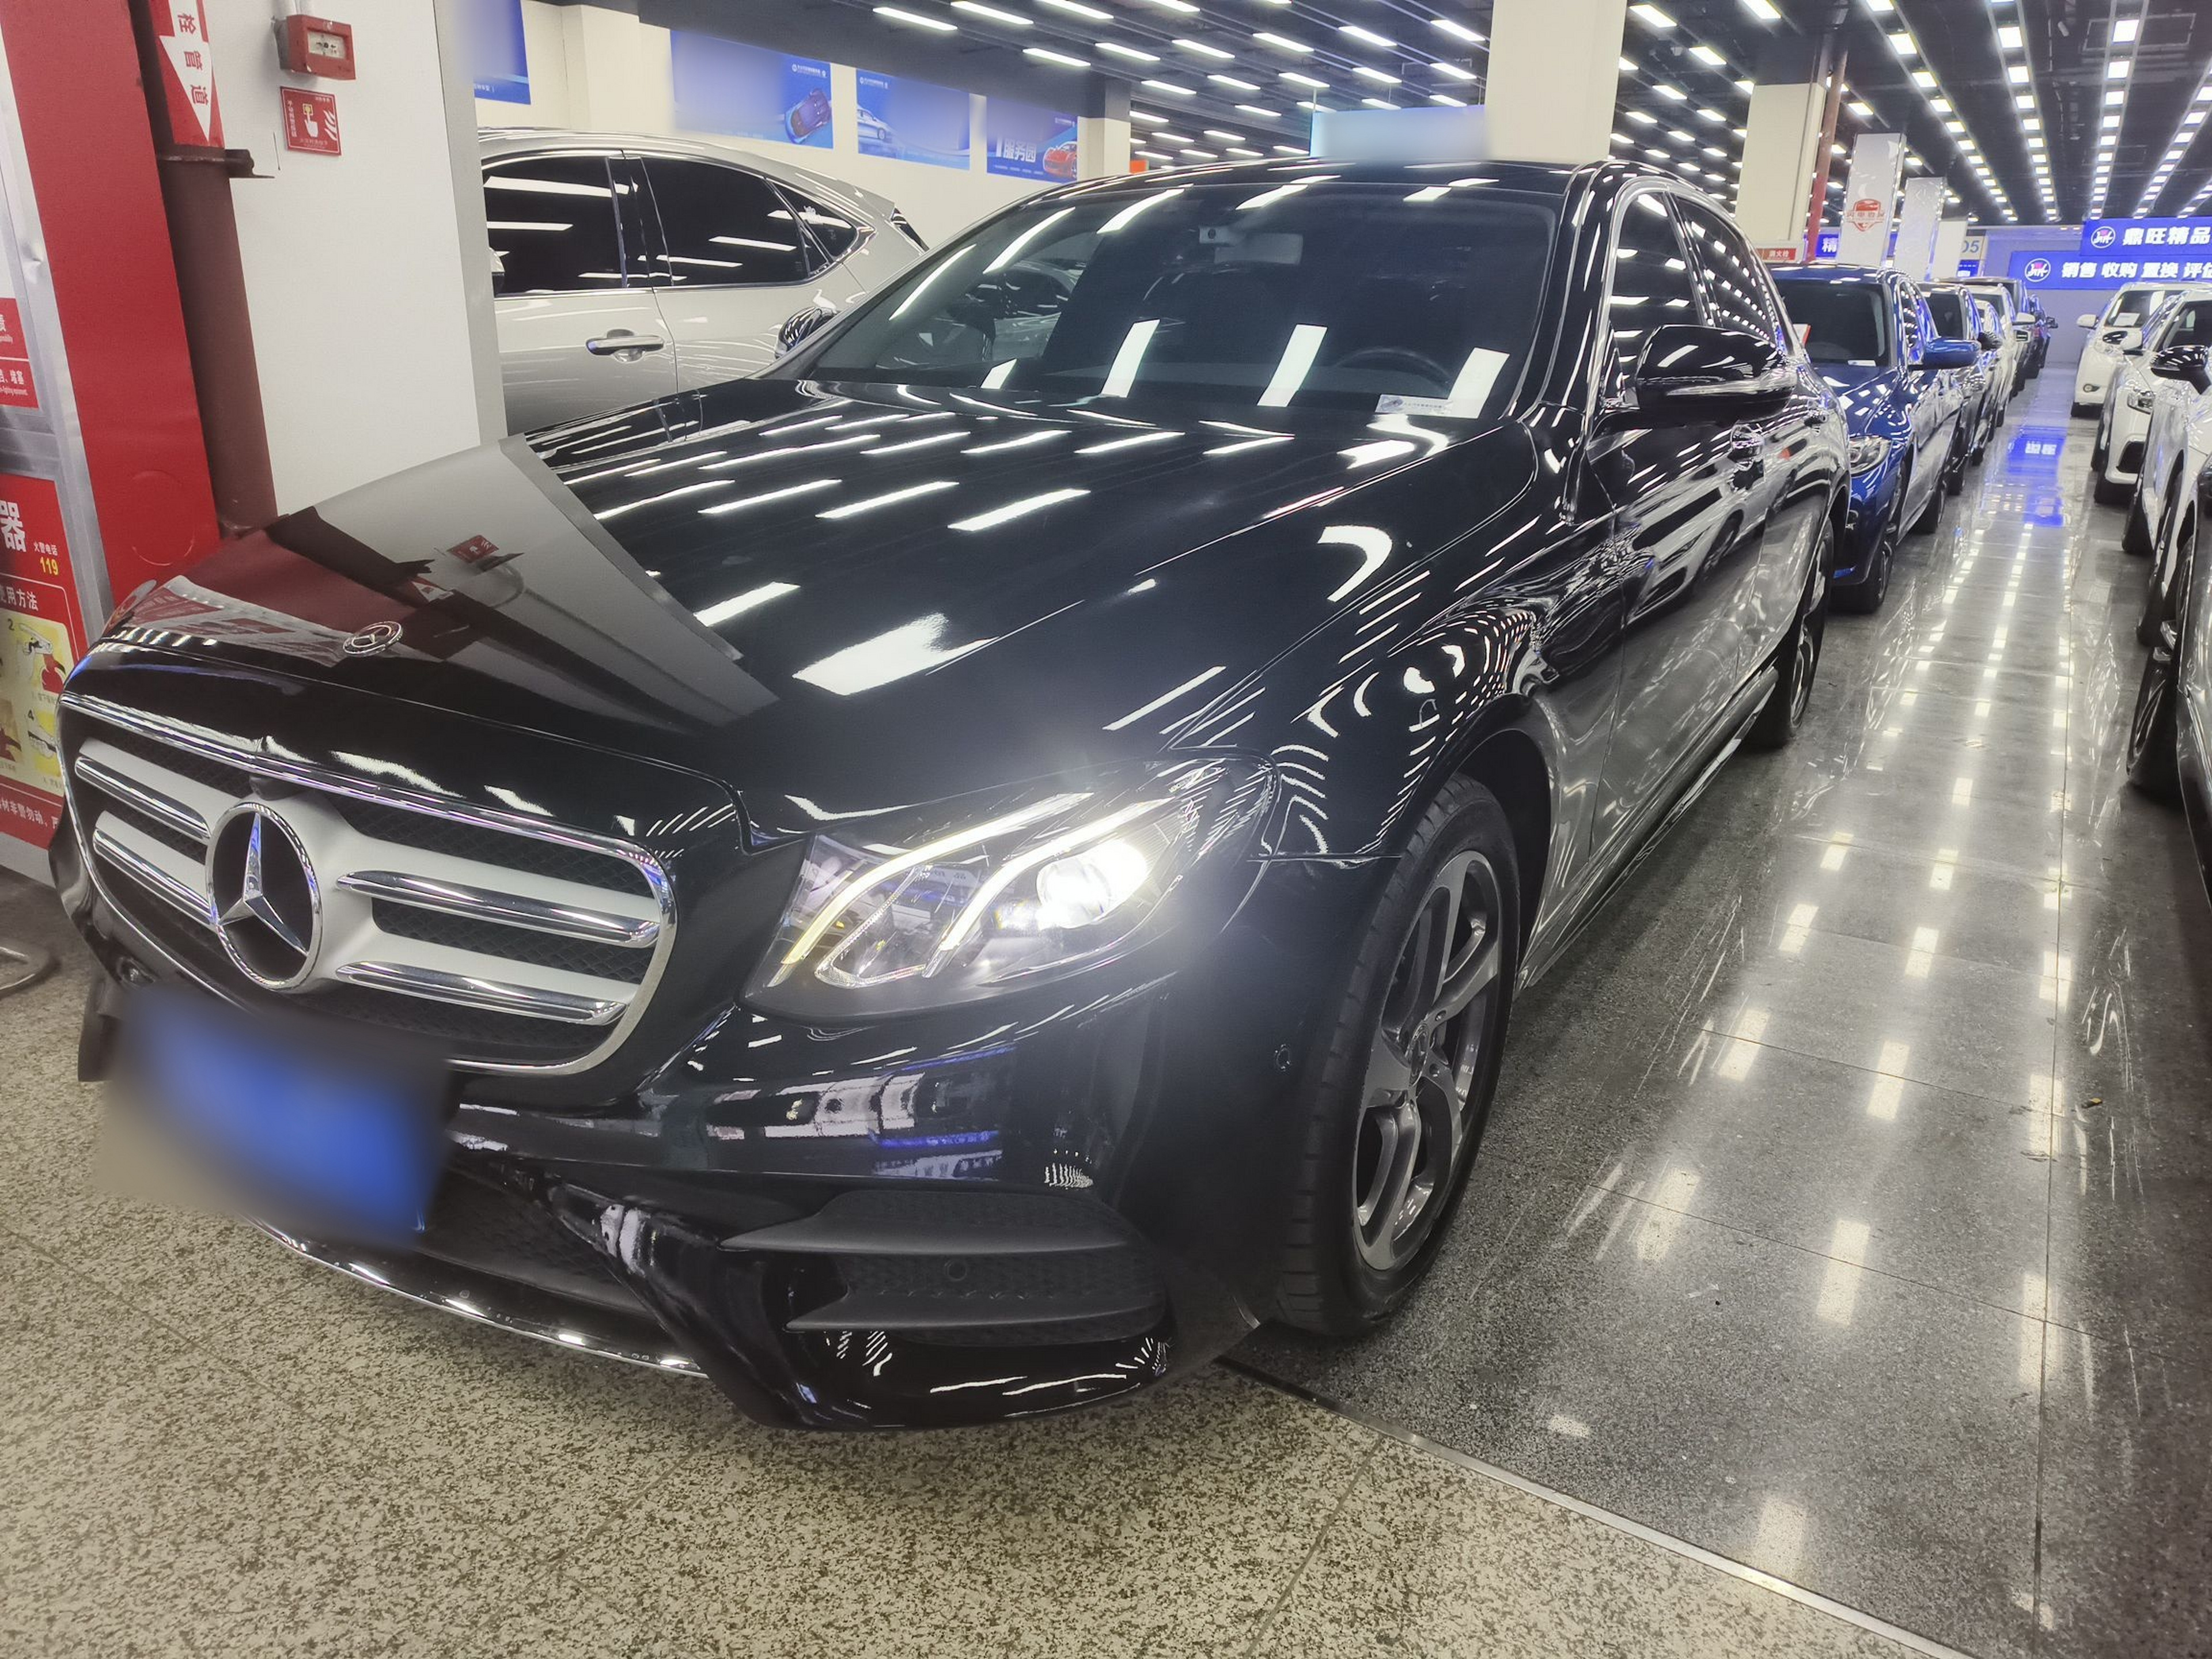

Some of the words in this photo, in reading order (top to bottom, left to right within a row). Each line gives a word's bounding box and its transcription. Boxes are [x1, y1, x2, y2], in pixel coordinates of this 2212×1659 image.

[2123, 226, 2211, 245] 鼎旺精品
[2062, 262, 2097, 278] 销售
[2101, 262, 2138, 278] 收购
[2141, 262, 2179, 278] 置换
[33, 541, 58, 556] 火警电话
[40, 556, 58, 575] 119
[7, 619, 15, 631] 2
[28, 709, 35, 721] 4
